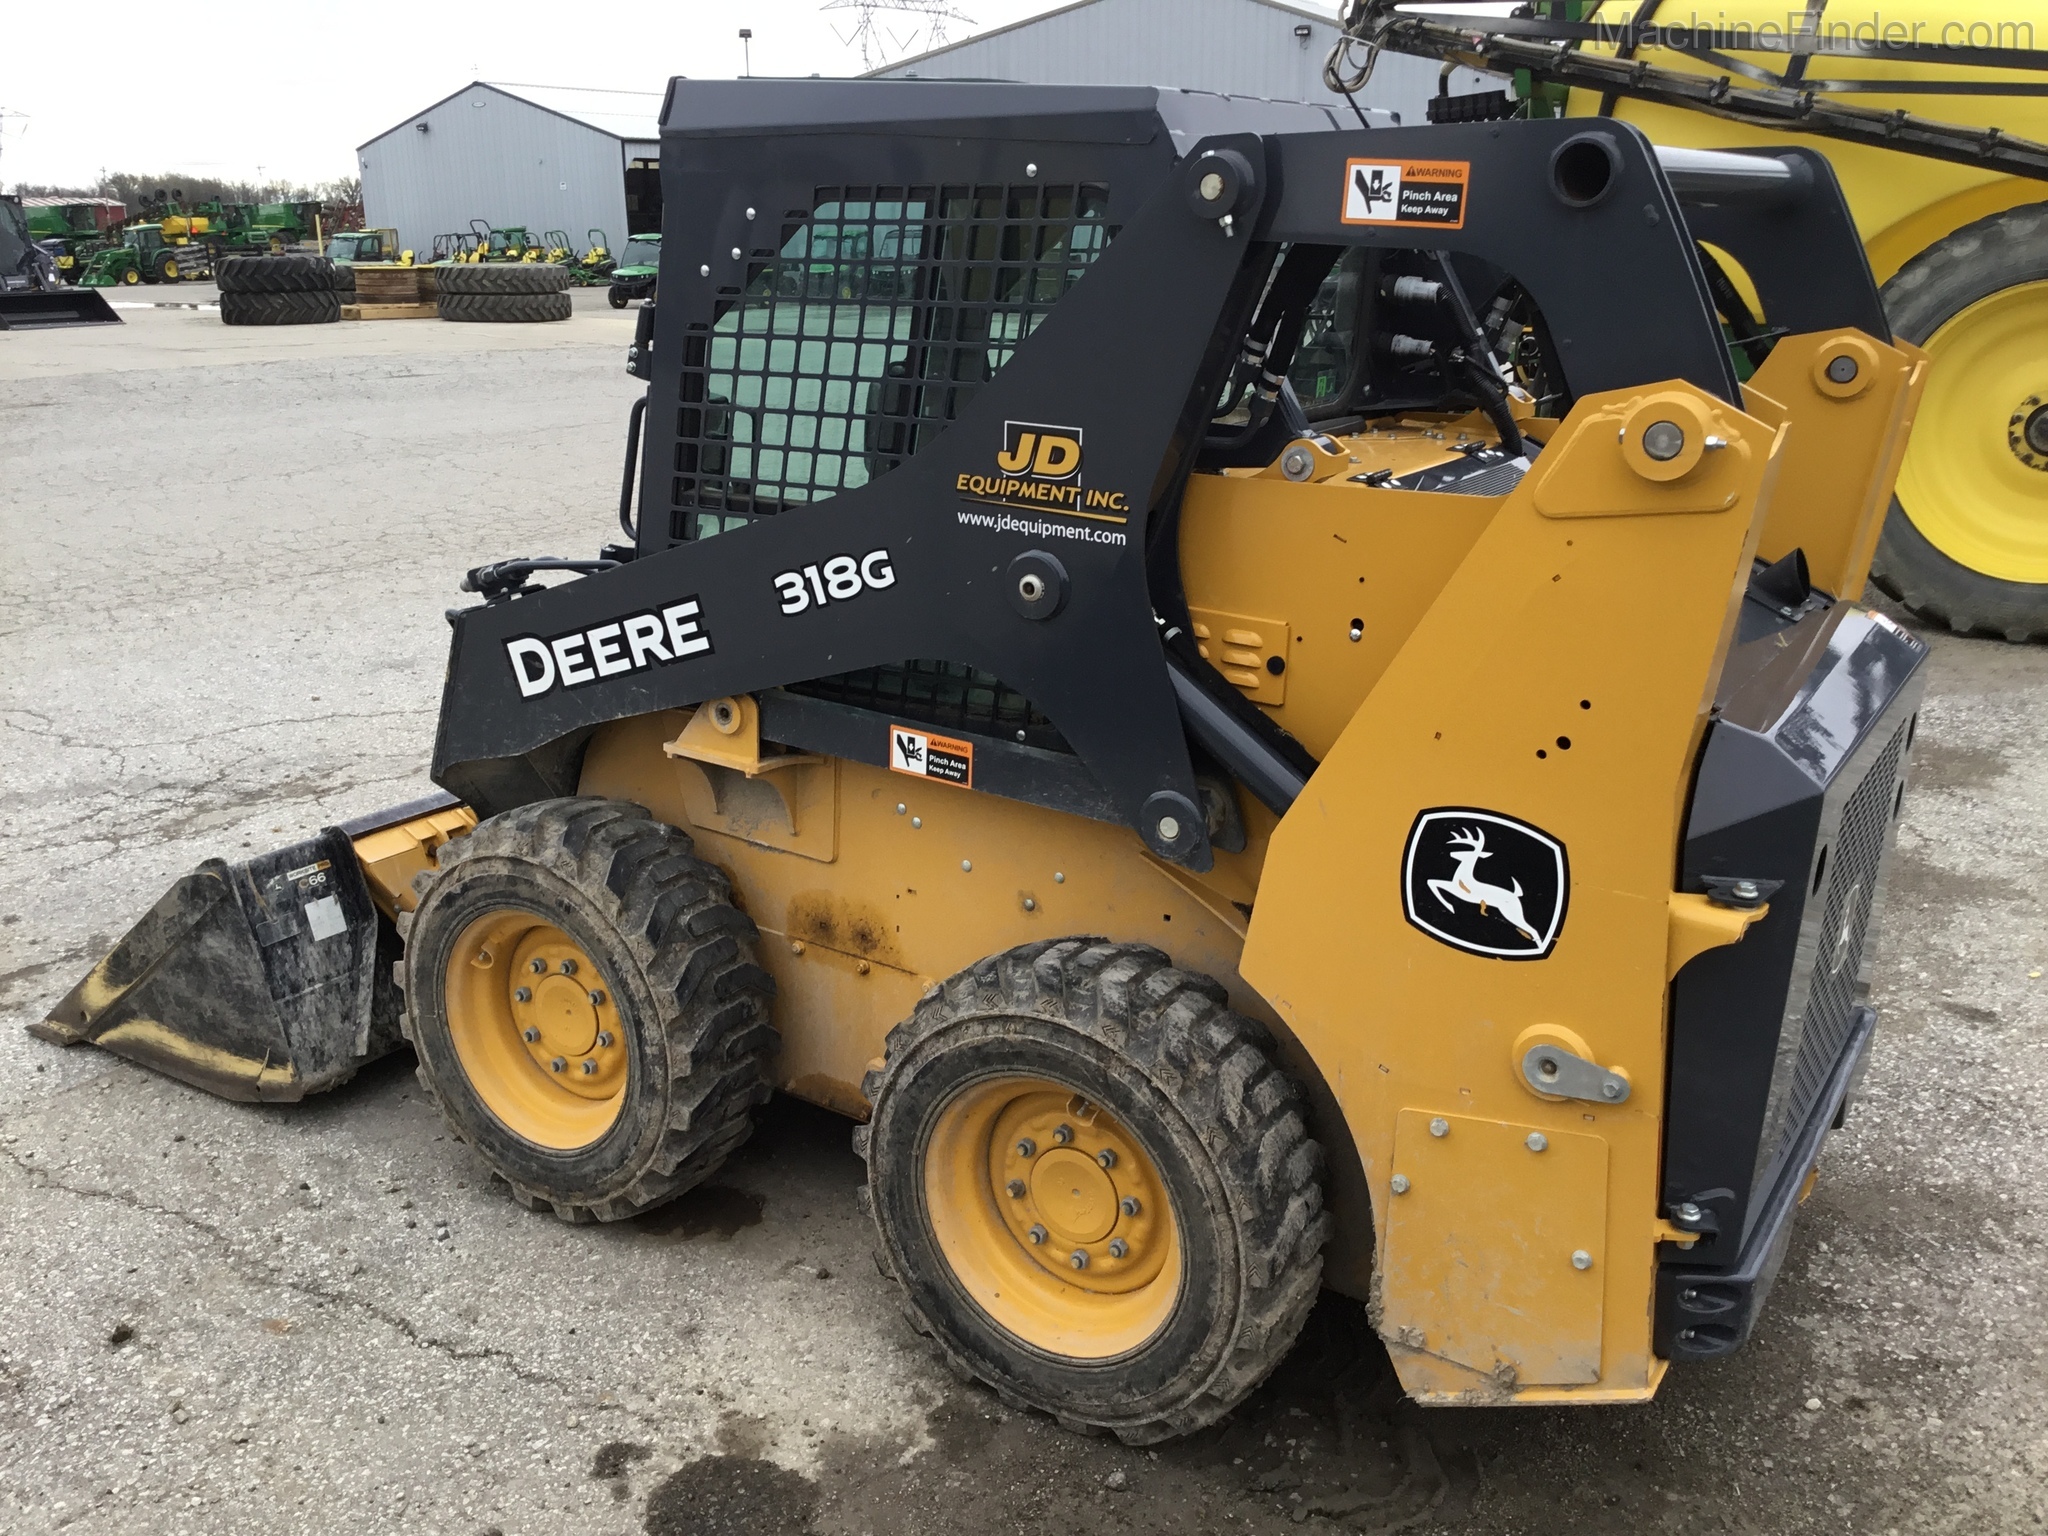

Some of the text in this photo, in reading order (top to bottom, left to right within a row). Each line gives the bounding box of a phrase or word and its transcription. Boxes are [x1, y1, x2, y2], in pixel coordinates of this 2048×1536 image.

[1416, 168, 1463, 178] WARNING
[1402, 190, 1458, 202] Pinch Area
[1401, 204, 1449, 217] Keep Away
[997, 432, 1082, 477] JD
[956, 473, 1130, 511] EQUIPMENT INC.
[957, 511, 1127, 546] www.jdequipment.com
[773, 549, 897, 615] 318G
[507, 600, 710, 698] DEERE
[937, 741, 968, 753] WARNING
[929, 755, 966, 770] Pinch Area
[929, 764, 961, 778] Keep Away
